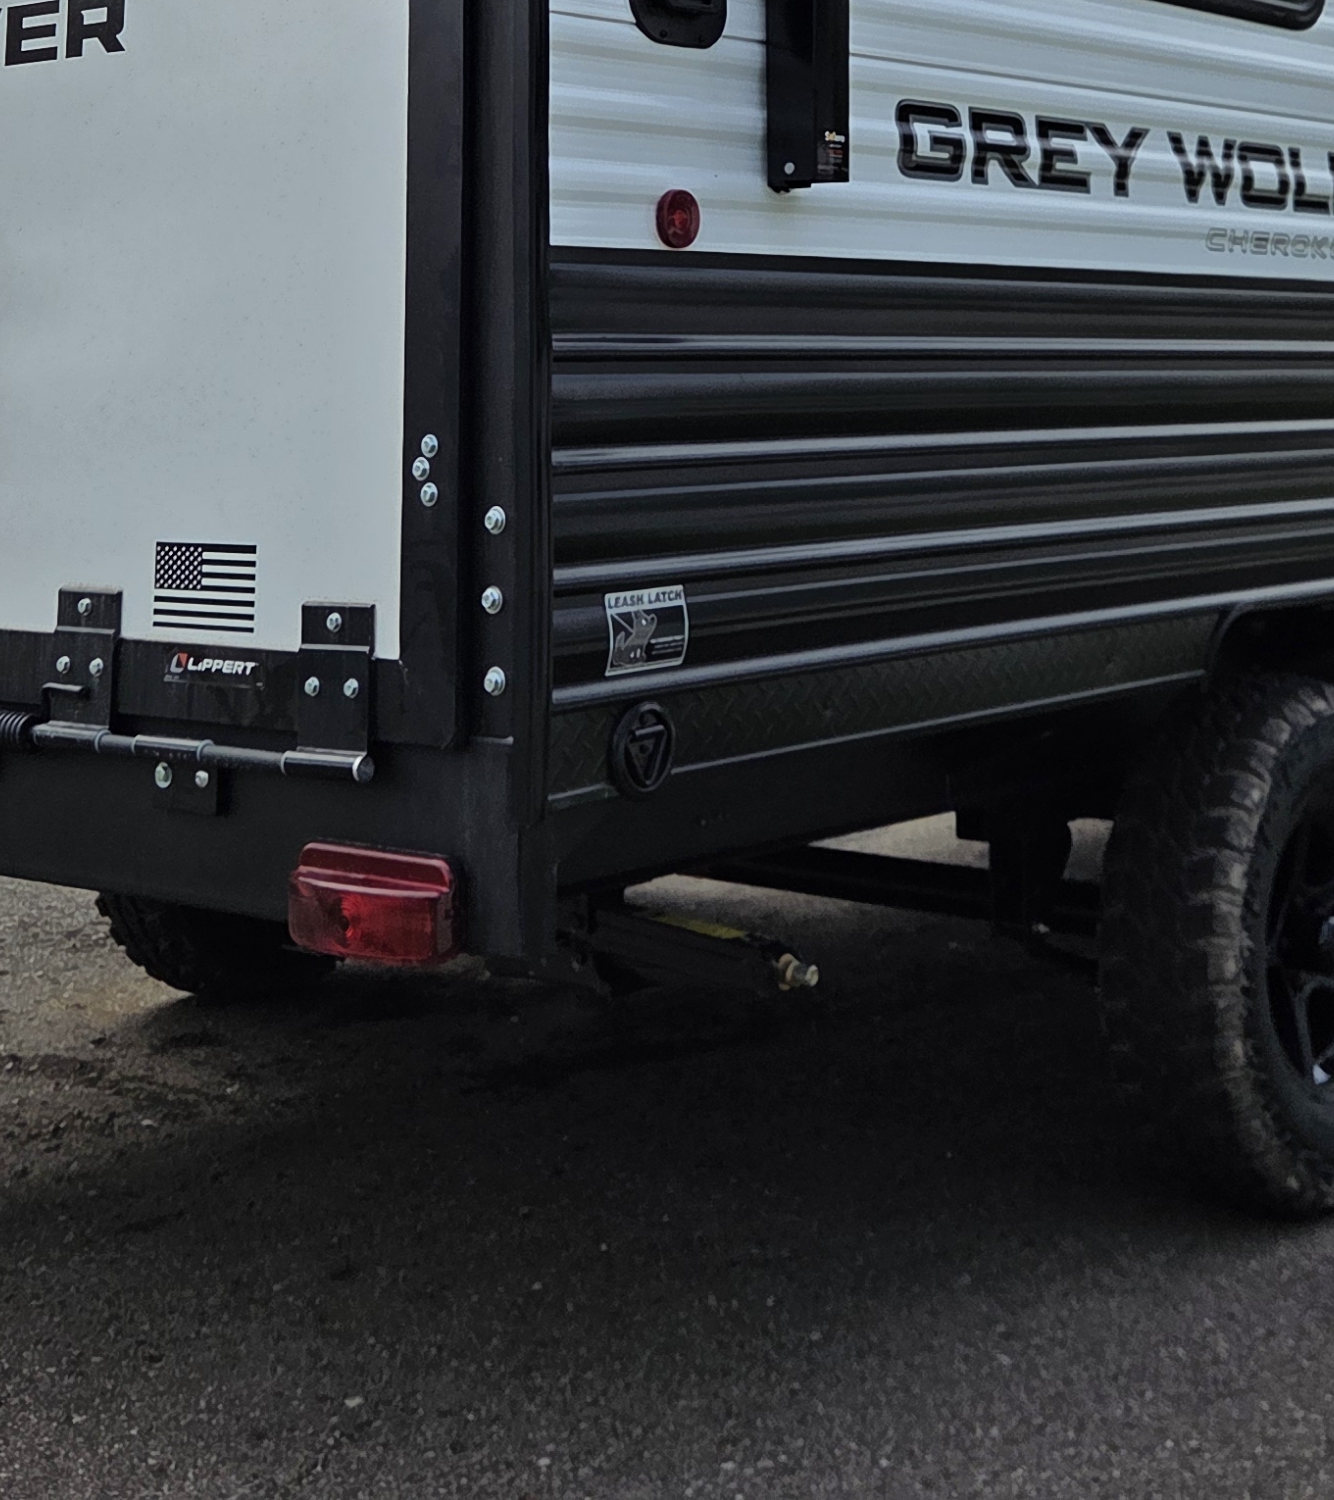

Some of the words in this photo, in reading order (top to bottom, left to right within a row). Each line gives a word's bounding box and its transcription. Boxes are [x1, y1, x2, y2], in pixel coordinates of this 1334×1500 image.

[894, 98, 1151, 198] GREY
[607, 594, 644, 609] LEASH
[648, 589, 683, 605] LATCH
